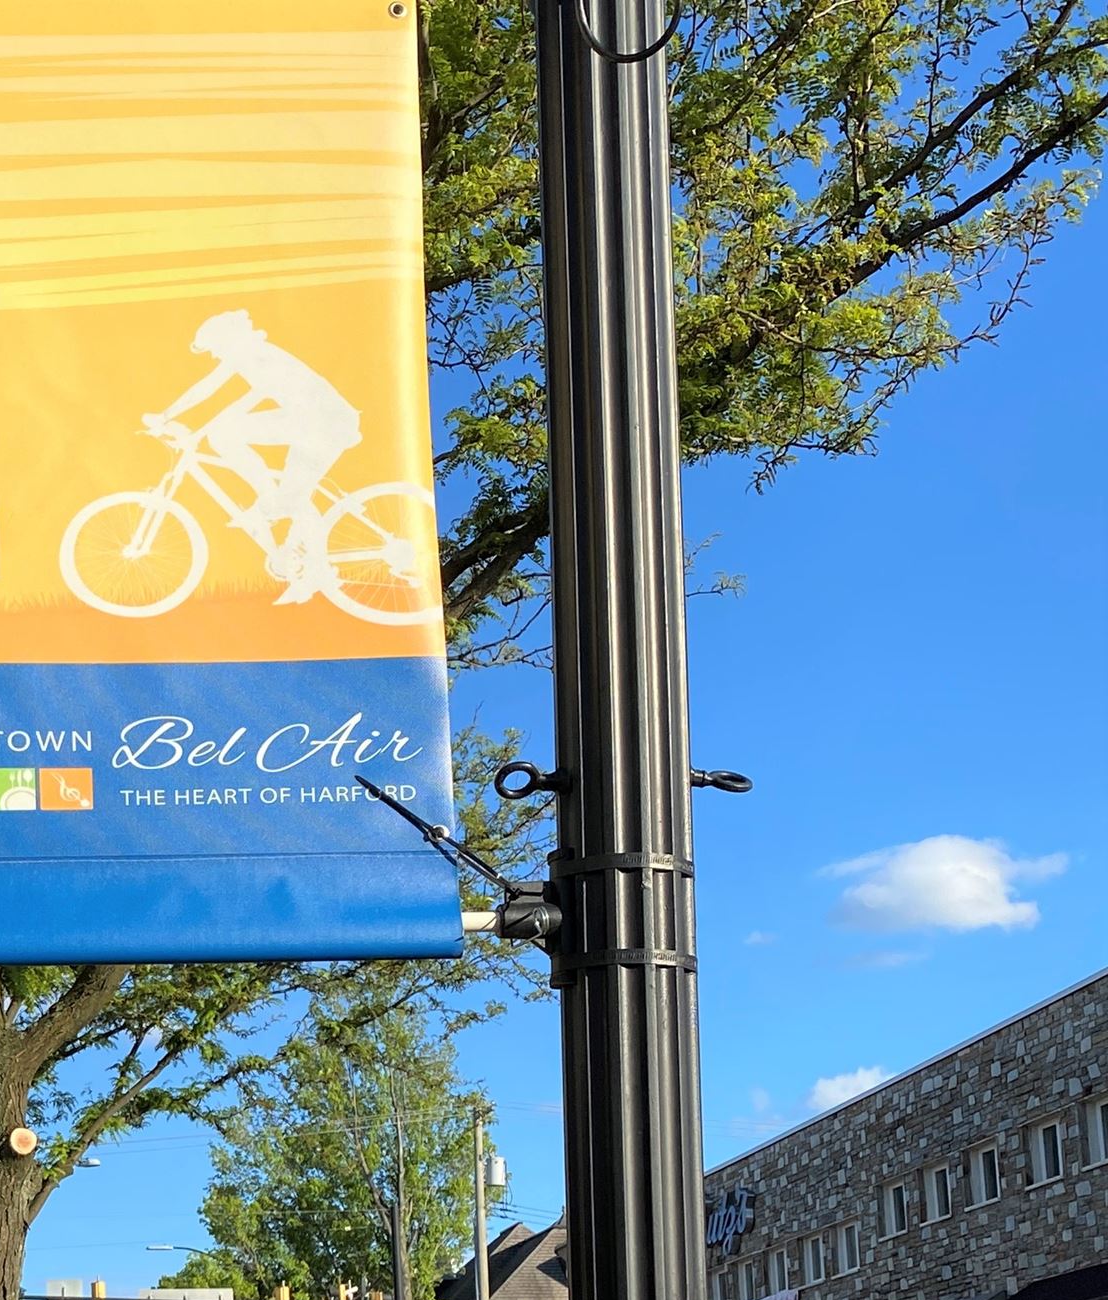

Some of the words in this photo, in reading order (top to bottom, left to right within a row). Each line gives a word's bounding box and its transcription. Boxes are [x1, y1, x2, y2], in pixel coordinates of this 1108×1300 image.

[111, 715, 248, 771] Bel
[255, 711, 423, 773] Air
[120, 788, 167, 808] THE
[173, 786, 253, 807] HEART
[259, 786, 293, 806] OF
